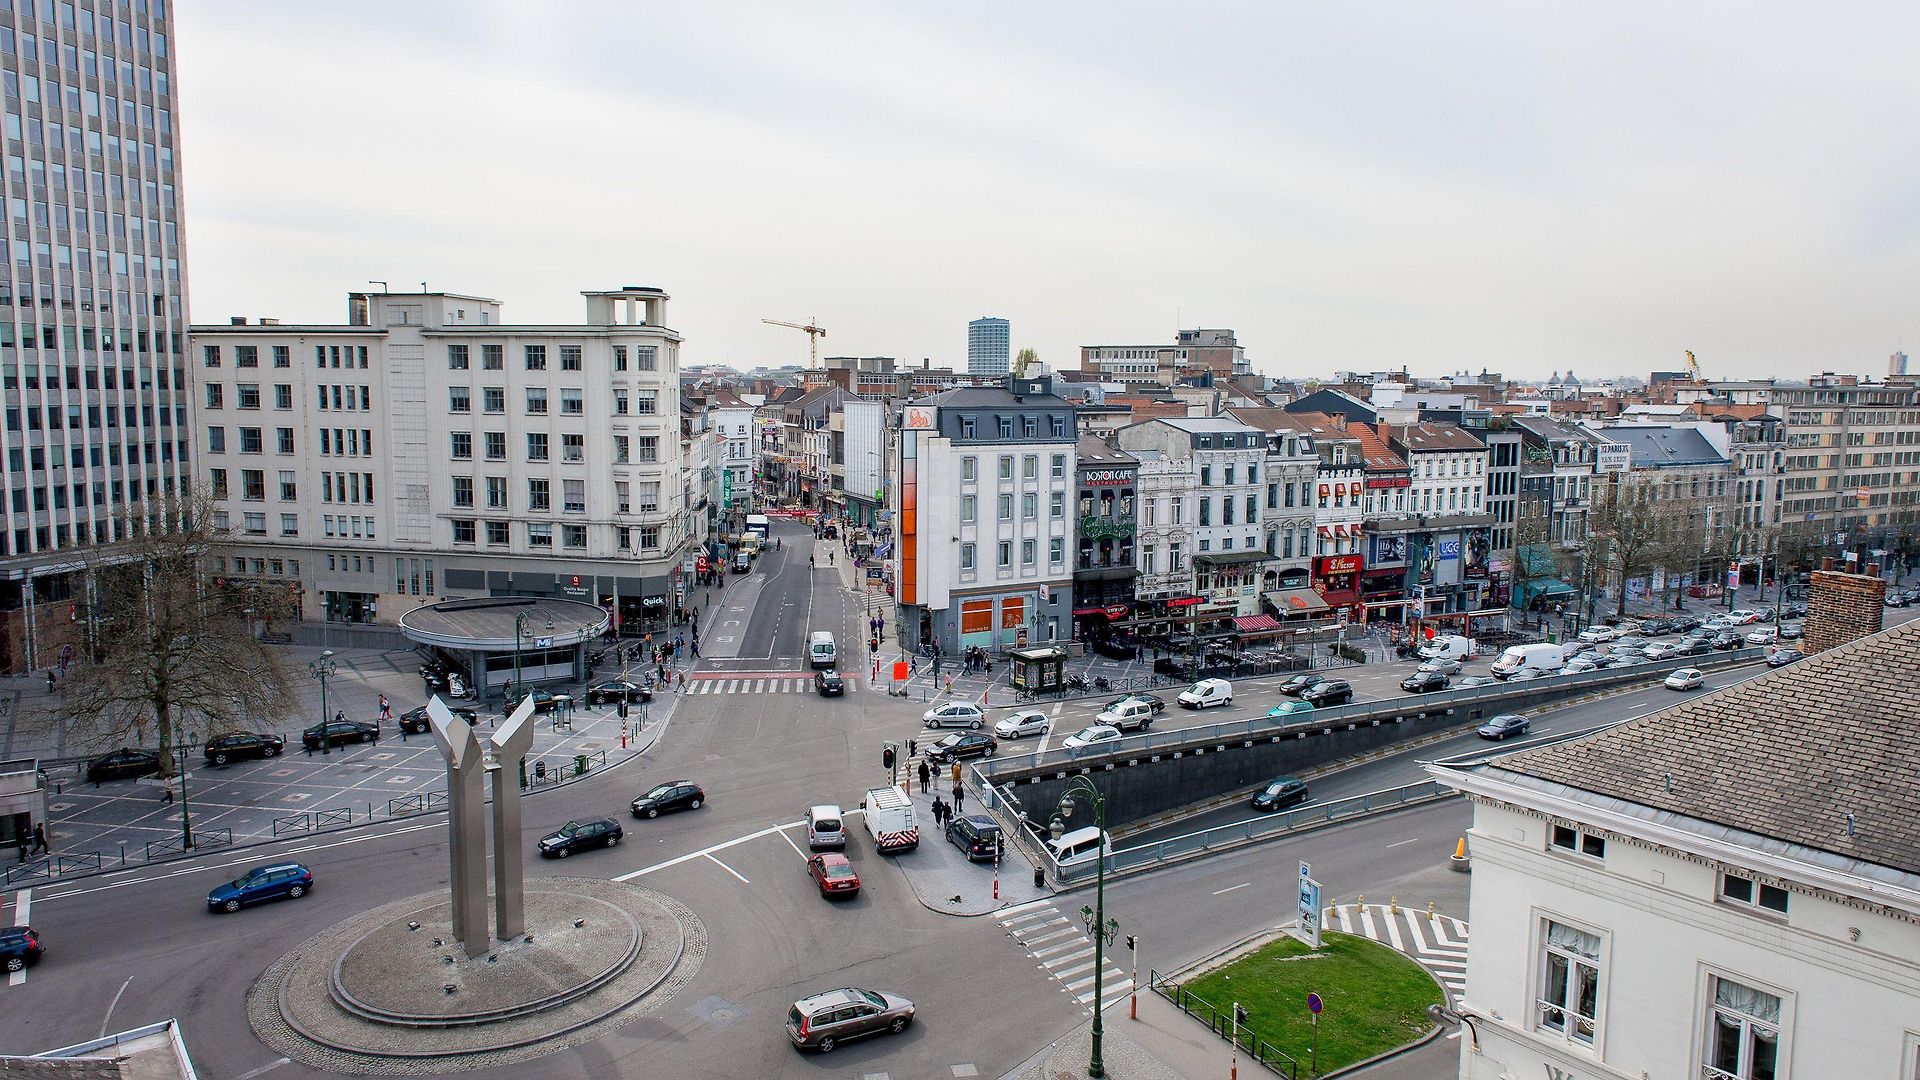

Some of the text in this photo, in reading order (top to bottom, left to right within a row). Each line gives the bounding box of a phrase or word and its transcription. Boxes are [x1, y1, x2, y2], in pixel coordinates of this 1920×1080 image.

[1086, 471, 1114, 481] BOSTON
[1441, 542, 1459, 553] UGC
[643, 597, 664, 606] Quick
